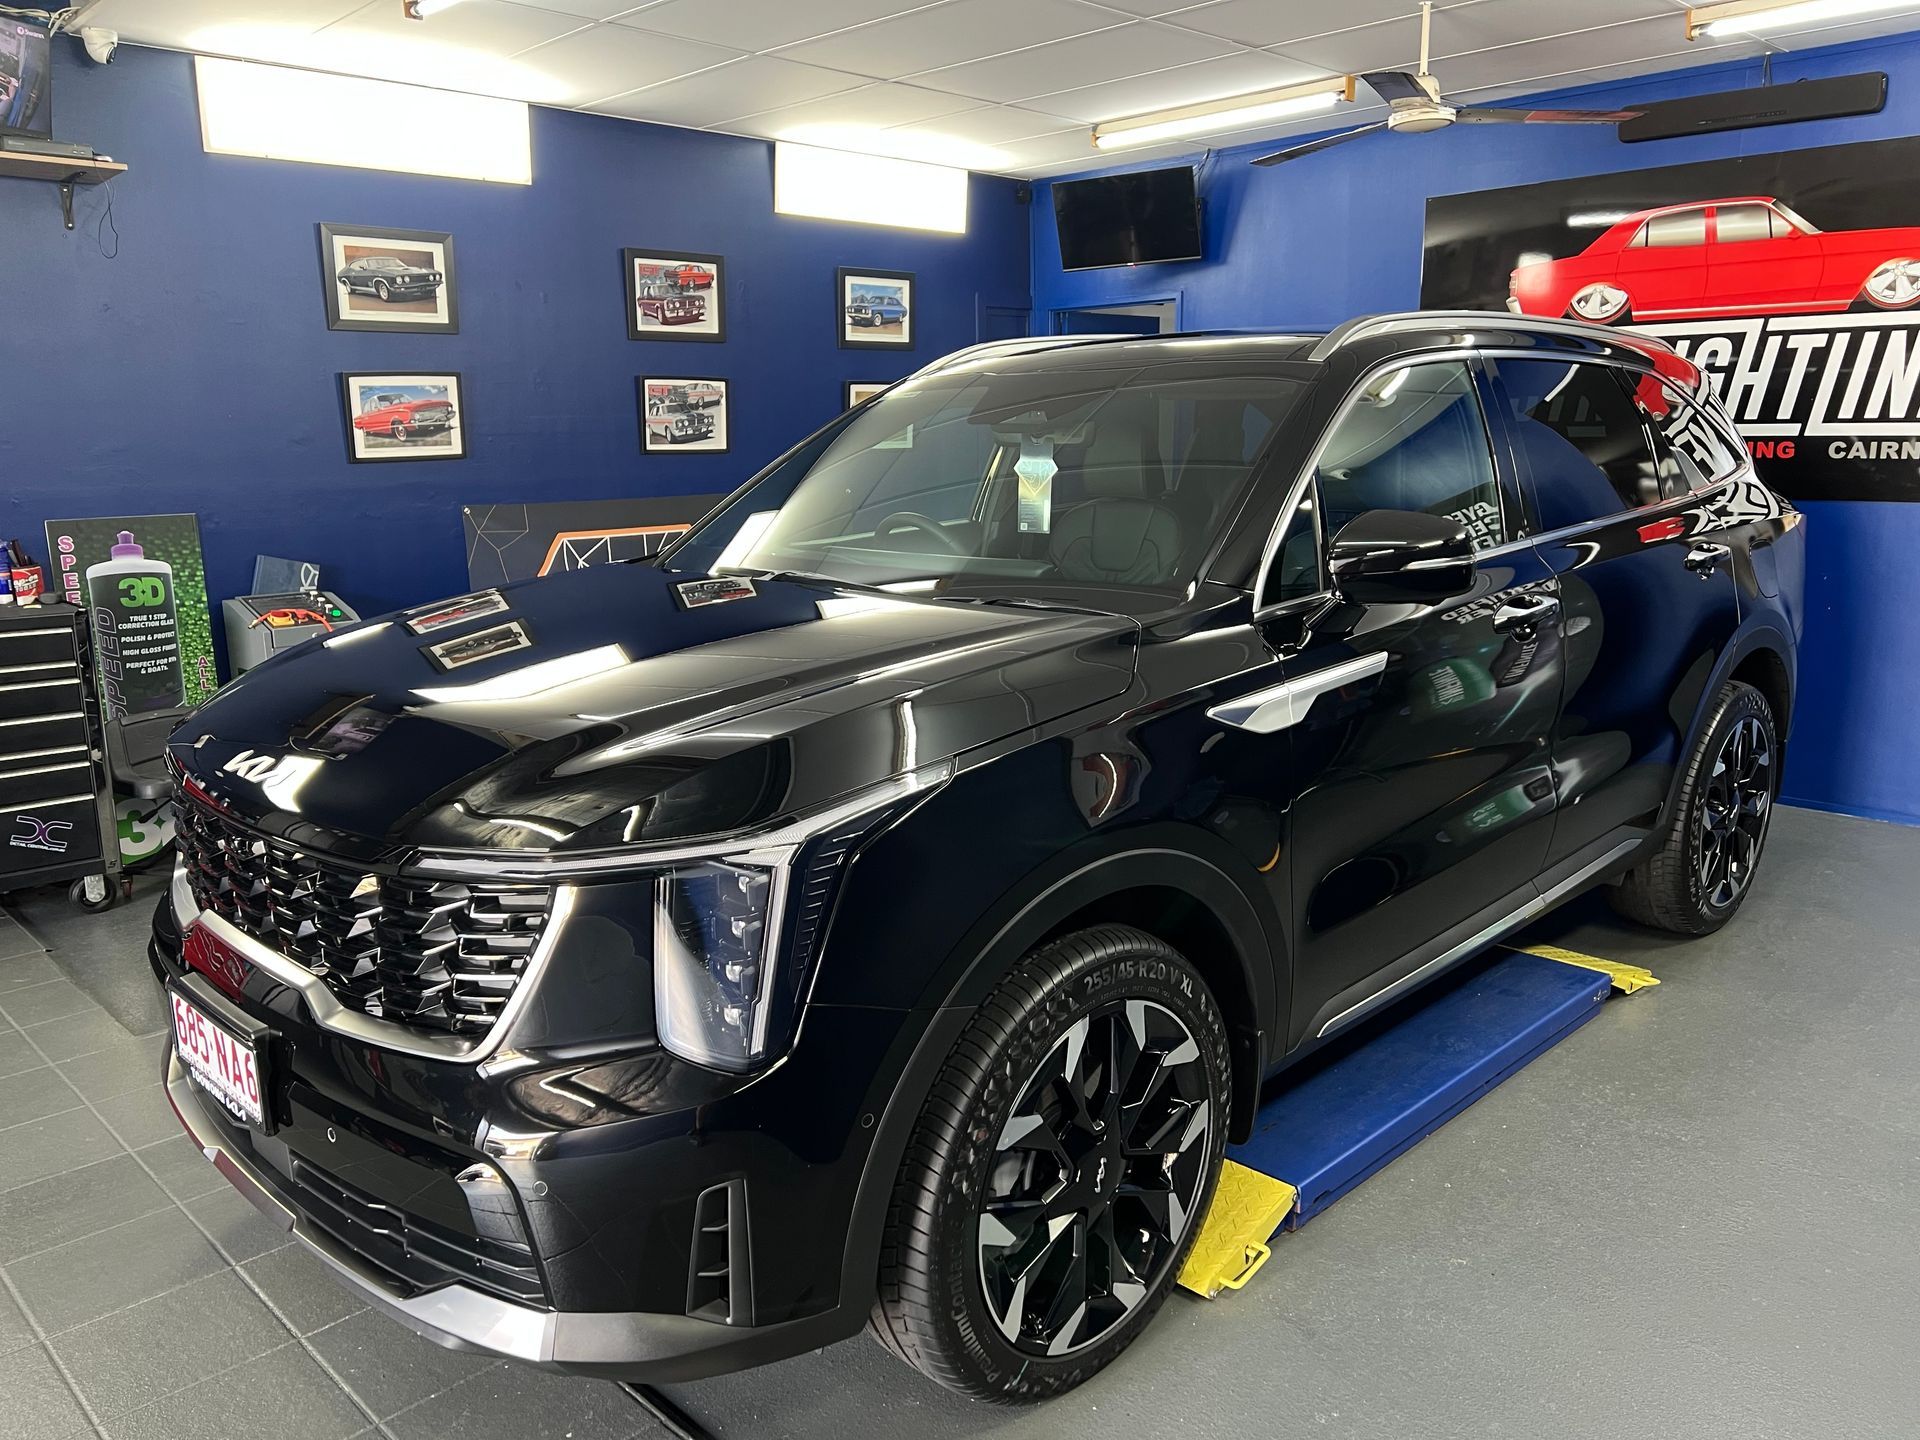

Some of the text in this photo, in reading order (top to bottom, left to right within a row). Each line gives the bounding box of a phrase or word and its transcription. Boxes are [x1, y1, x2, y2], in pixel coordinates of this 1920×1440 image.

[1828, 441, 1920, 459] CAIRN
[118, 577, 165, 607] 3D
[118, 620, 160, 629] CORRECTION
[121, 635, 146, 643] POLISH
[153, 631, 175, 639] PROTECT
[141, 646, 161, 654] GLOSS
[126, 660, 155, 668] PERFECT
[1084, 961, 1136, 995] 255/45
[1180, 973, 1195, 998] XL
